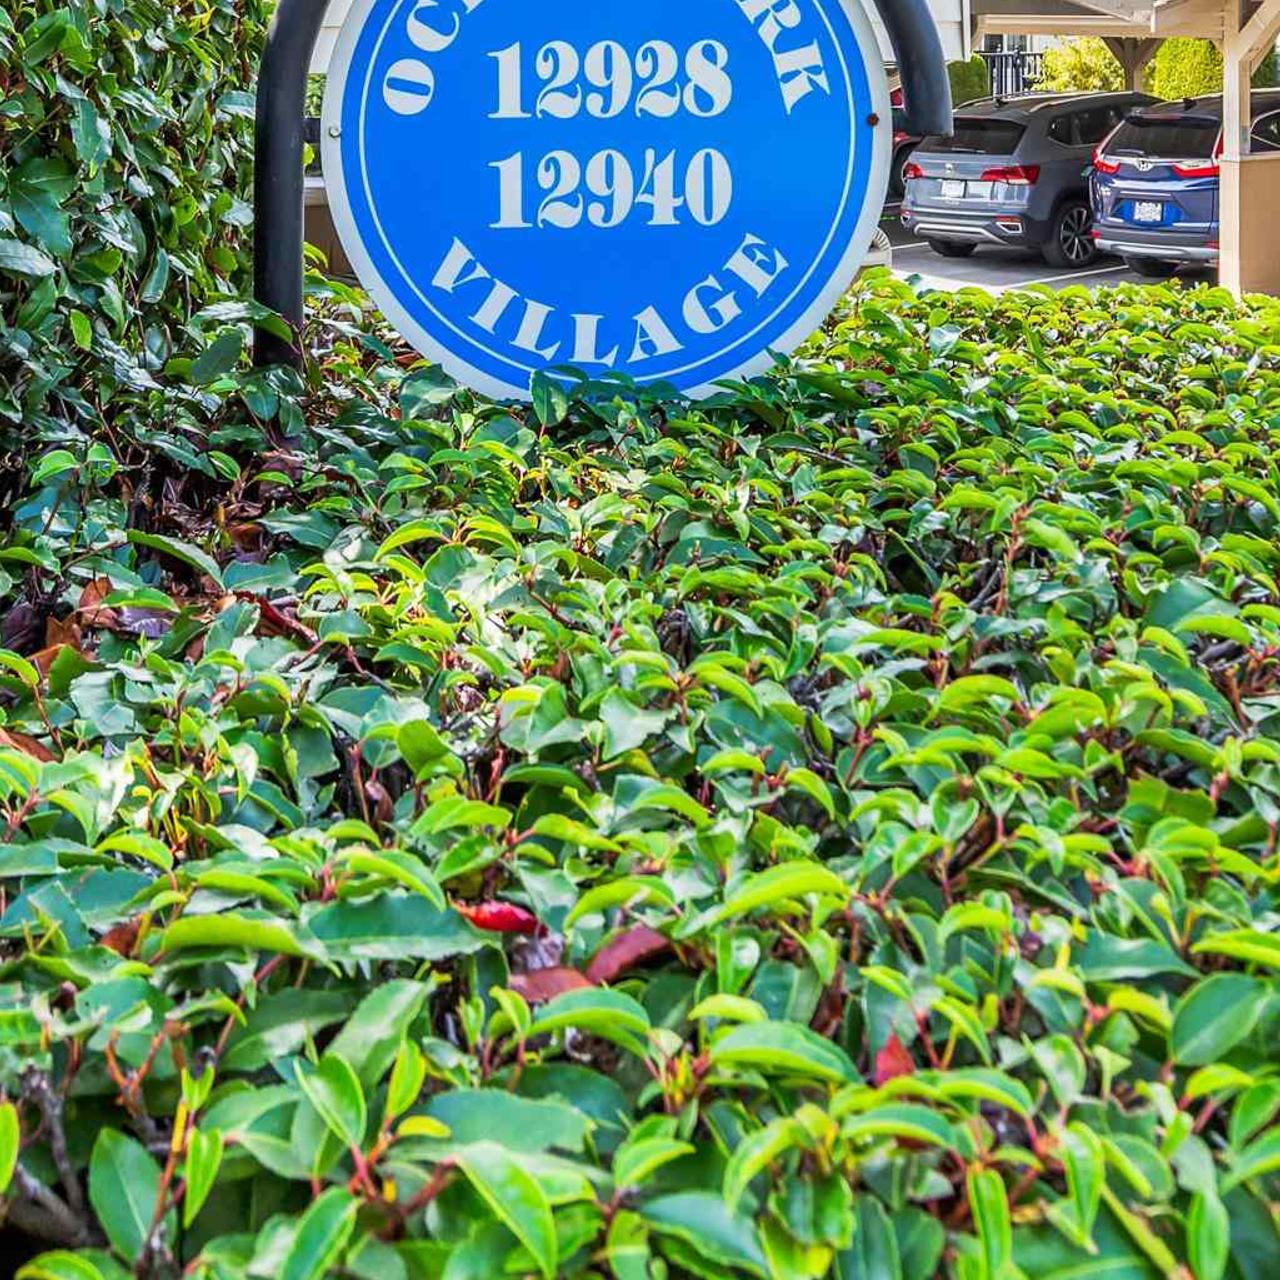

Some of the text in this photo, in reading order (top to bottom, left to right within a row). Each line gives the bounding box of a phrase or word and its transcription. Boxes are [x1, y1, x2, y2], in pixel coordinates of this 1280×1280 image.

[486, 38, 734, 119] 12928
[487, 147, 734, 229] 12940
[430, 232, 790, 368] VILLAGE
